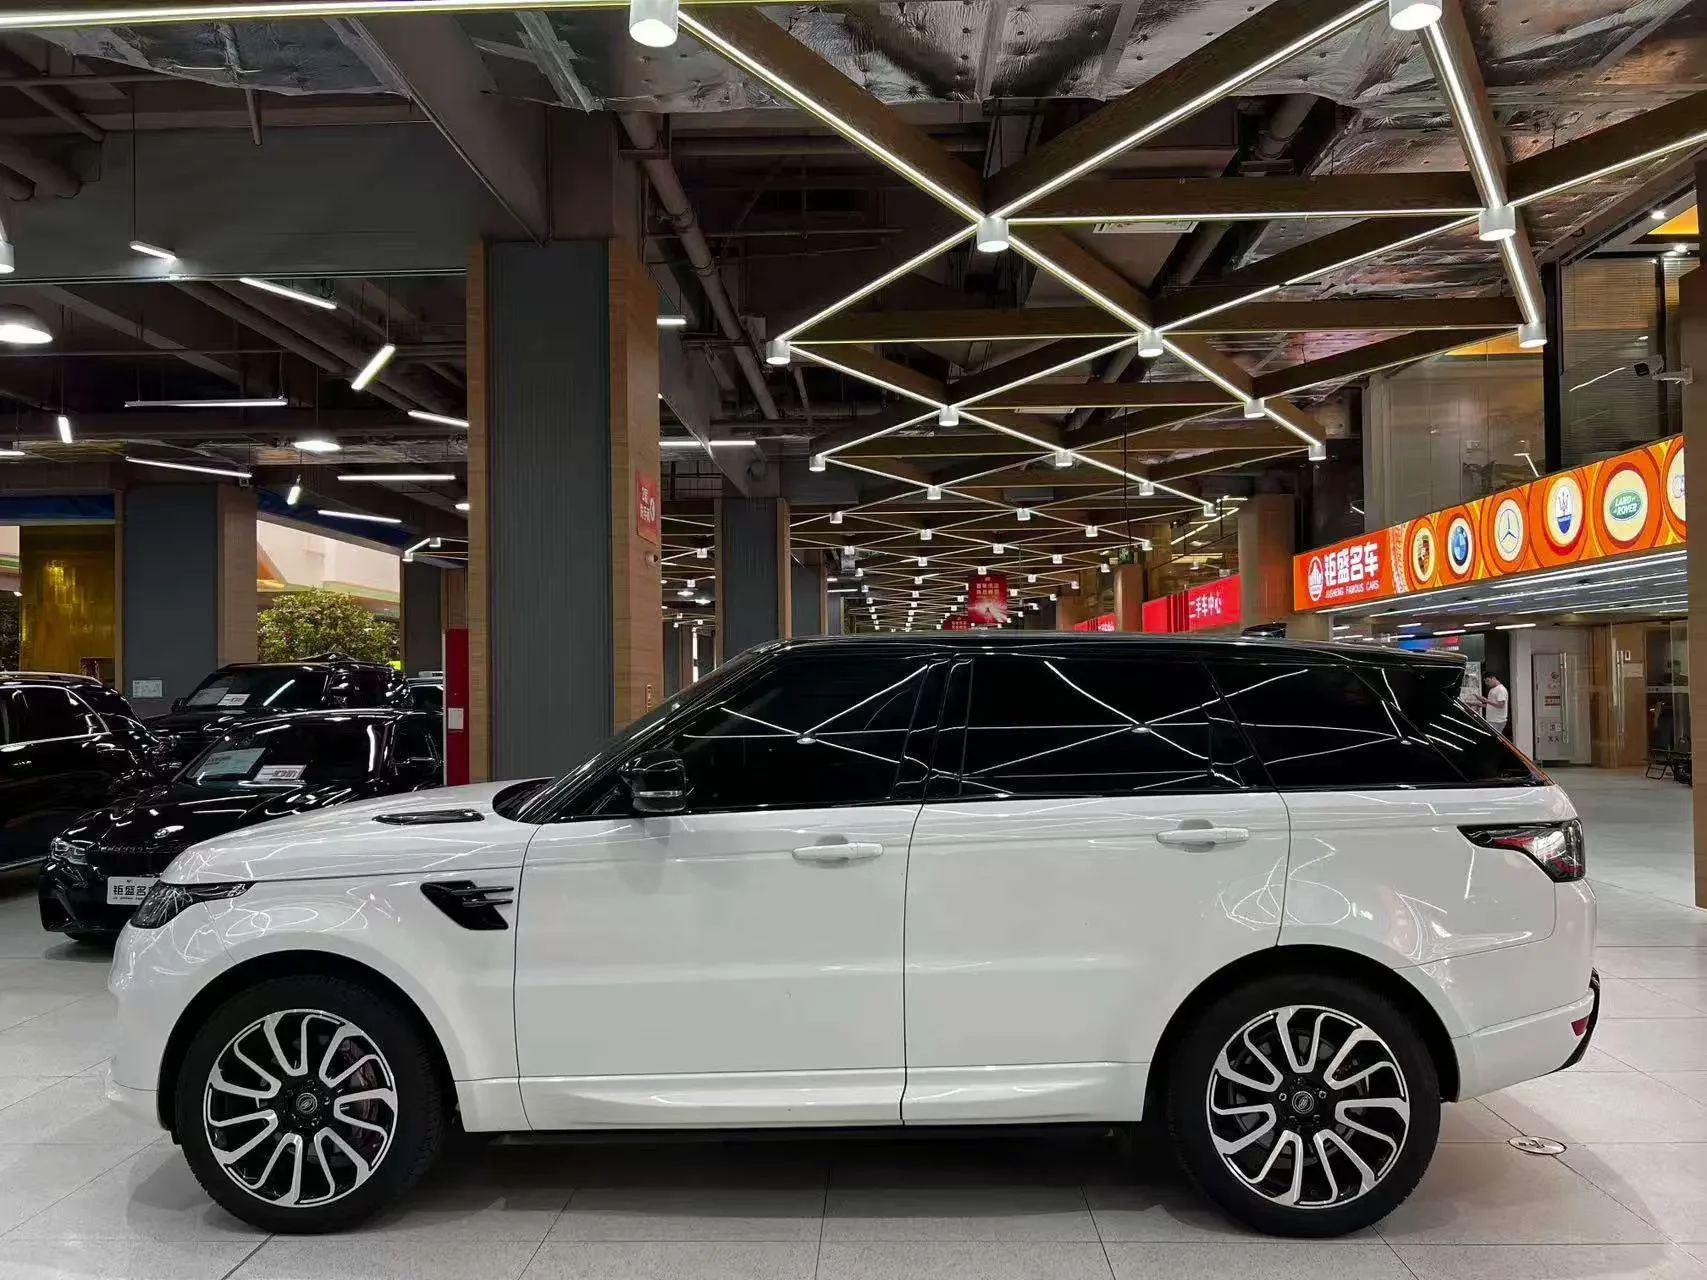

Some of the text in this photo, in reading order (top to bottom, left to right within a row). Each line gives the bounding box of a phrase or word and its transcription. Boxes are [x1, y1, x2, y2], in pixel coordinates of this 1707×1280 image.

[1614, 495, 1632, 507] LAND
[1616, 502, 1638, 516] ROVER
[1323, 541, 1379, 587] 钜盛名车
[1189, 591, 1222, 618] 二手车中心
[113, 885, 151, 896] 钜盛名
